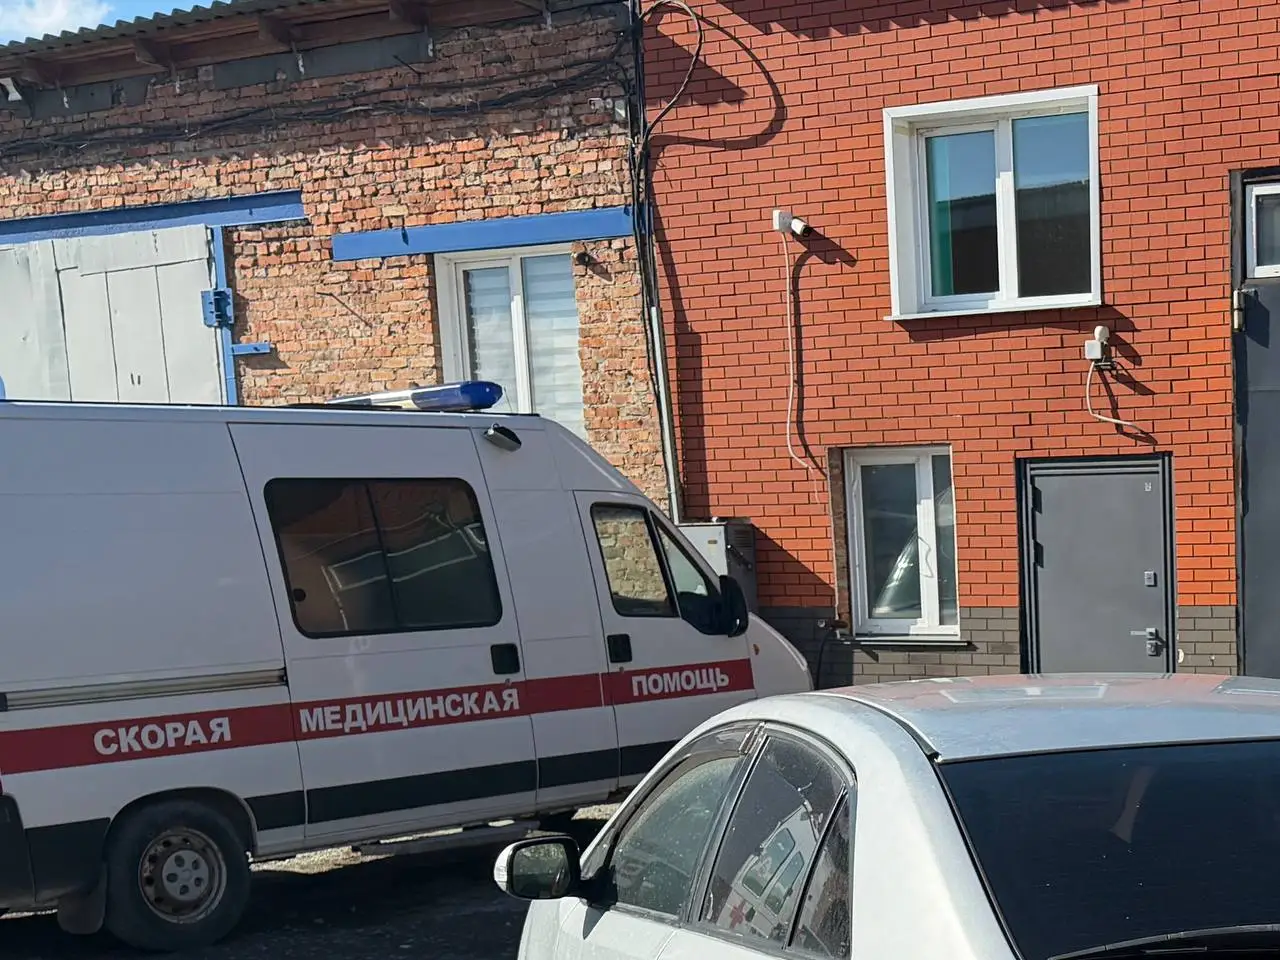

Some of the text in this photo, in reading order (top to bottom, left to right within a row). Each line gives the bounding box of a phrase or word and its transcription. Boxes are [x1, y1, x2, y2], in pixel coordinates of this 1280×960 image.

[93, 667, 730, 756] СКОРАЯ МЕДИЦИНСКАЯ ПОМОЩЬ
